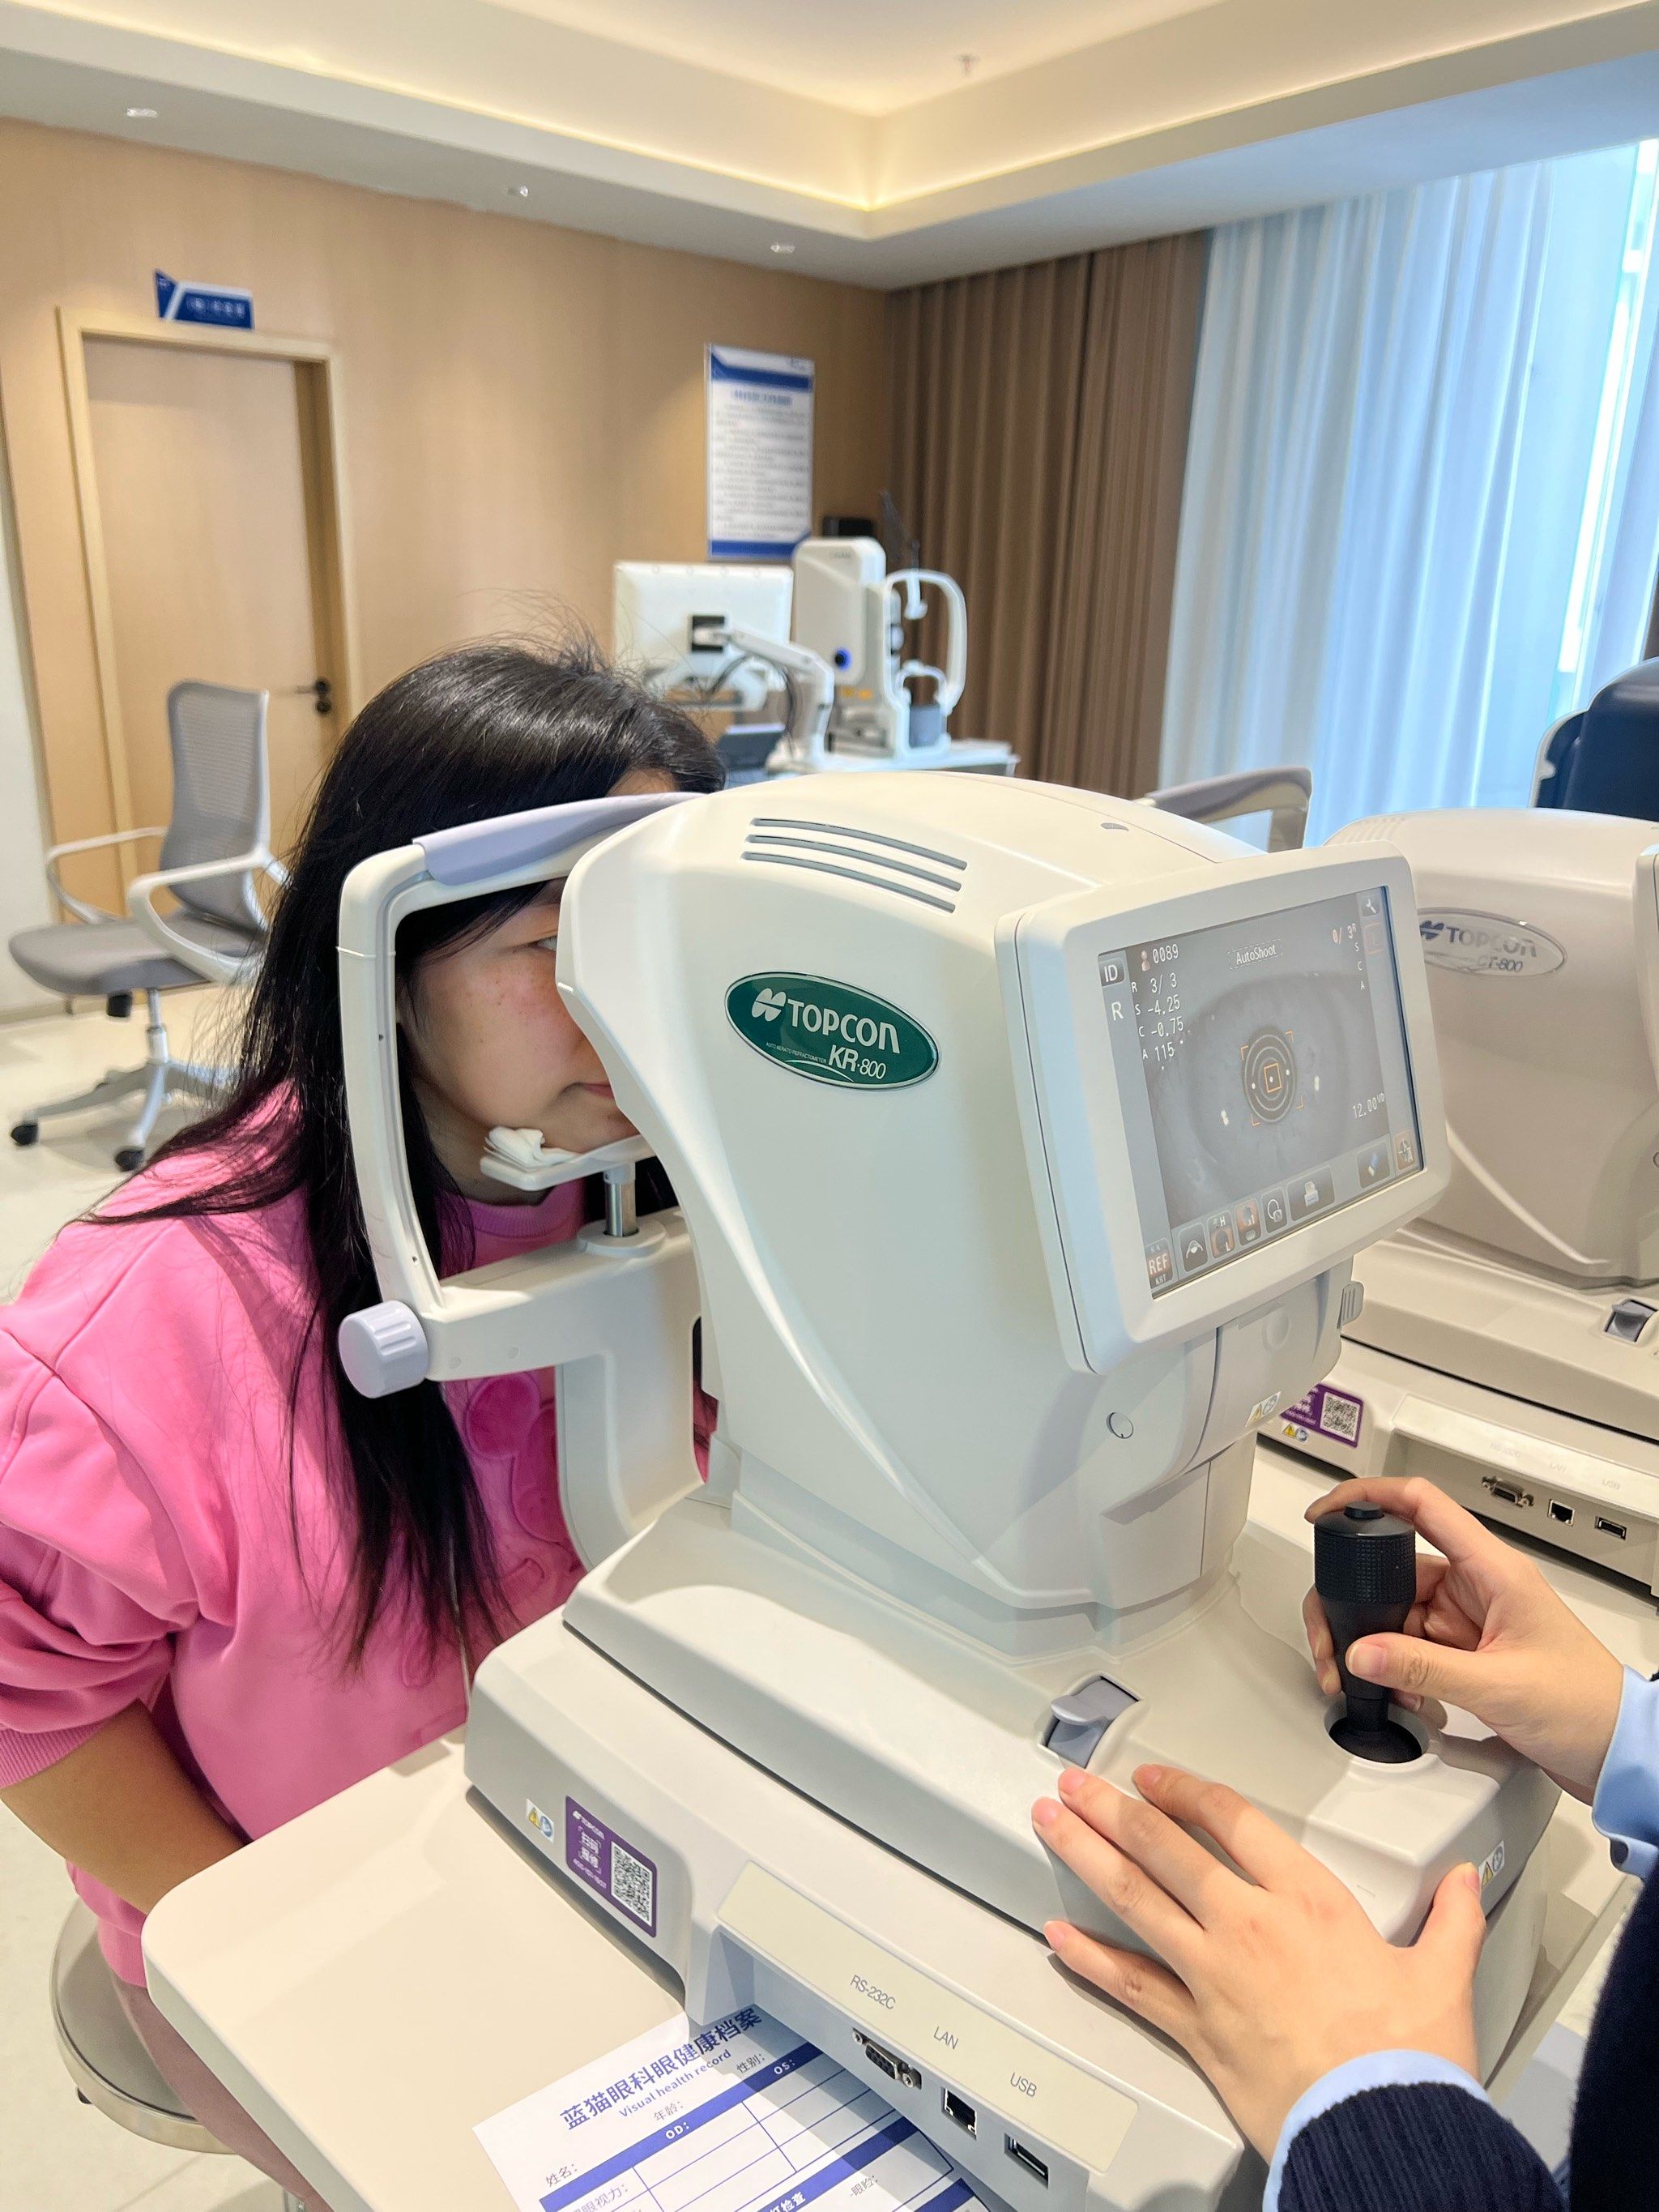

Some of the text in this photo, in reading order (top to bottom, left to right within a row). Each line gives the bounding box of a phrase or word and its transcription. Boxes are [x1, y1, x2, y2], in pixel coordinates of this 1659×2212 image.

[1446, 926, 1537, 957] TOPON
[1152, 944, 1179, 963] 0089
[1236, 944, 1277, 965] AutoShoot
[1104, 964, 1118, 982] ID
[1132, 982, 1138, 993] R
[1111, 1001, 1124, 1021] R
[1135, 994, 1180, 1015] S -4.25
[787, 998, 900, 1054] TOPCON
[1138, 1016, 1183, 1037] C -0.75
[1142, 1041, 1175, 1061] A 115
[1148, 1253, 1169, 1275] REF
[850, 1975, 896, 2010] RS-232C
[933, 2026, 959, 2050] LAN
[560, 2007, 762, 2130] 蓝猫眼科眼健康档案
[619, 2049, 731, 2117] Visual health record
[1009, 2073, 1038, 2098] USB
[572, 2184, 629, 2212] 眼视力：
